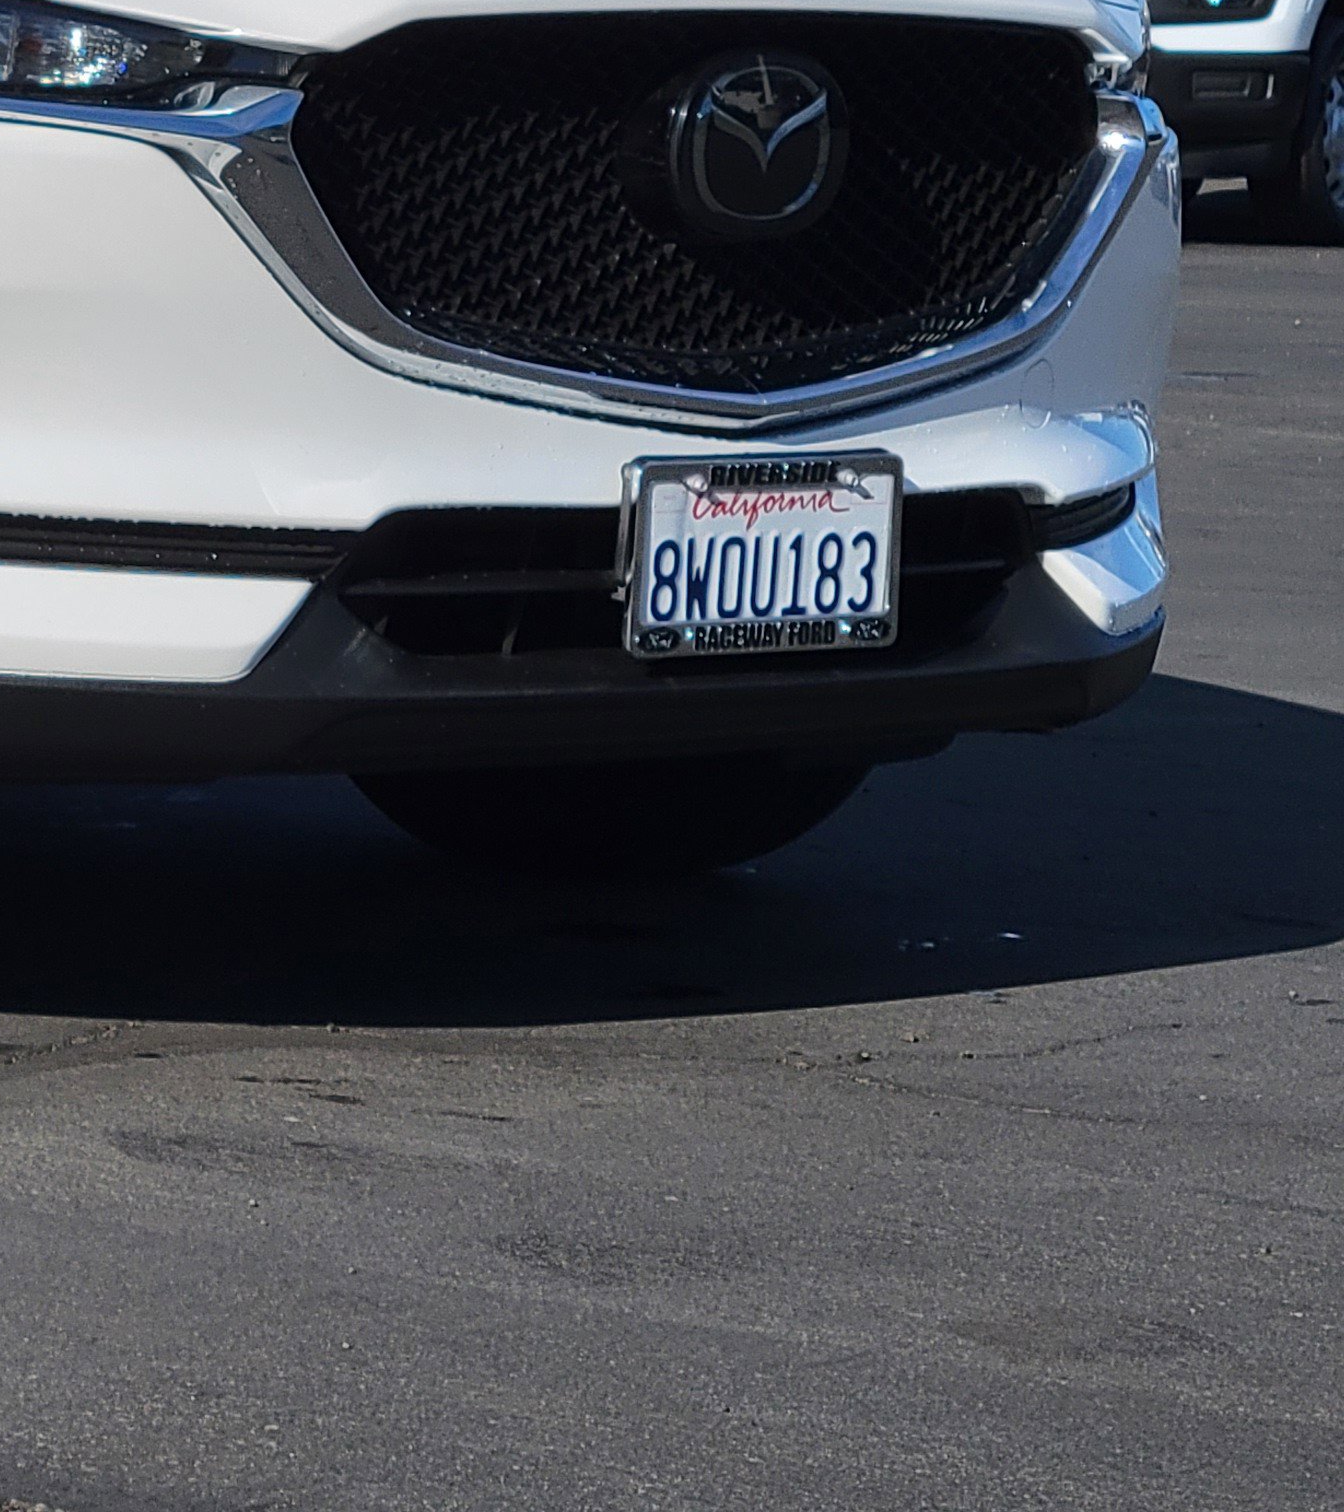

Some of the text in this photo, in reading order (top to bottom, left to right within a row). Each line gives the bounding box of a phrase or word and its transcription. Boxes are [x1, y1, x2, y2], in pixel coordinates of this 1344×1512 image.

[710, 460, 841, 486] RIVERSIDE
[692, 491, 850, 530] California
[649, 531, 877, 622] 8WOU183
[694, 622, 784, 651] RACEWAY
[787, 620, 836, 645] FORD
